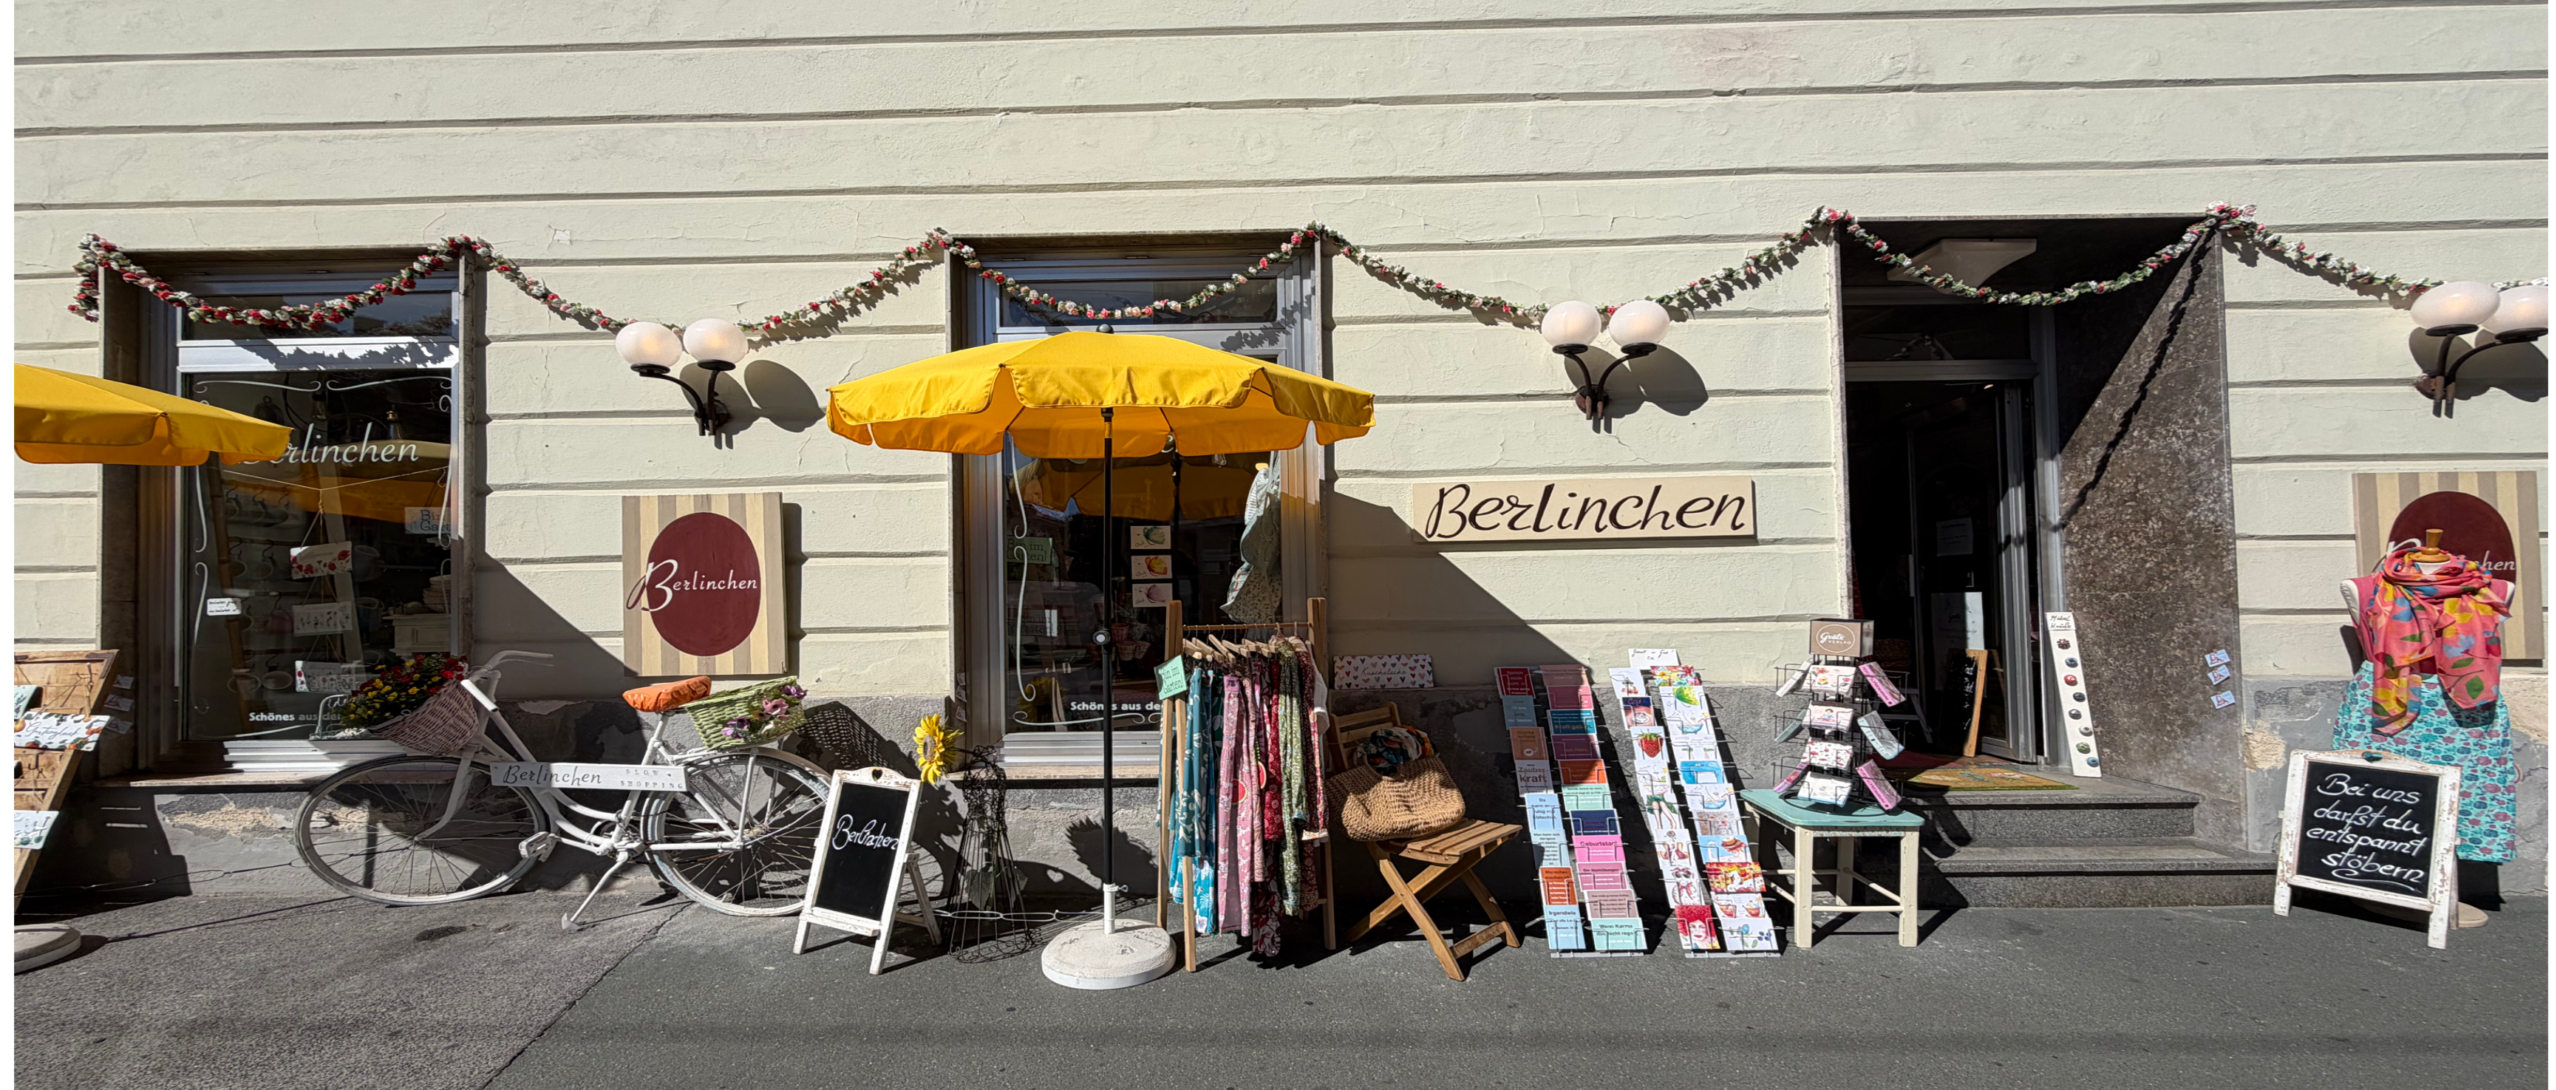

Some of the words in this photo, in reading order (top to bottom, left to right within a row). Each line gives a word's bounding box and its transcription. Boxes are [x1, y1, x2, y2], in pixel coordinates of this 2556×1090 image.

[237, 422, 419, 465] rlinchen
[1424, 483, 1746, 539] Berlinchen
[626, 558, 758, 612] Berlinchen
[248, 712, 295, 722] Schönes
[298, 713, 317, 721] aus
[1070, 701, 1117, 711] Schöns
[1121, 702, 1142, 711] aus
[1145, 701, 1163, 711] de
[502, 764, 602, 787] Berlinchen
[625, 768, 660, 777] SLOW
[620, 780, 684, 790] SHOPPING
[1519, 774, 1548, 783] kraft
[2316, 773, 2371, 797] Bei
[2372, 787, 2421, 805] uns
[2313, 799, 2388, 831] darfst
[2382, 808, 2422, 835] du
[2306, 826, 2428, 857] entspannt
[2320, 847, 2425, 883] stöbern
